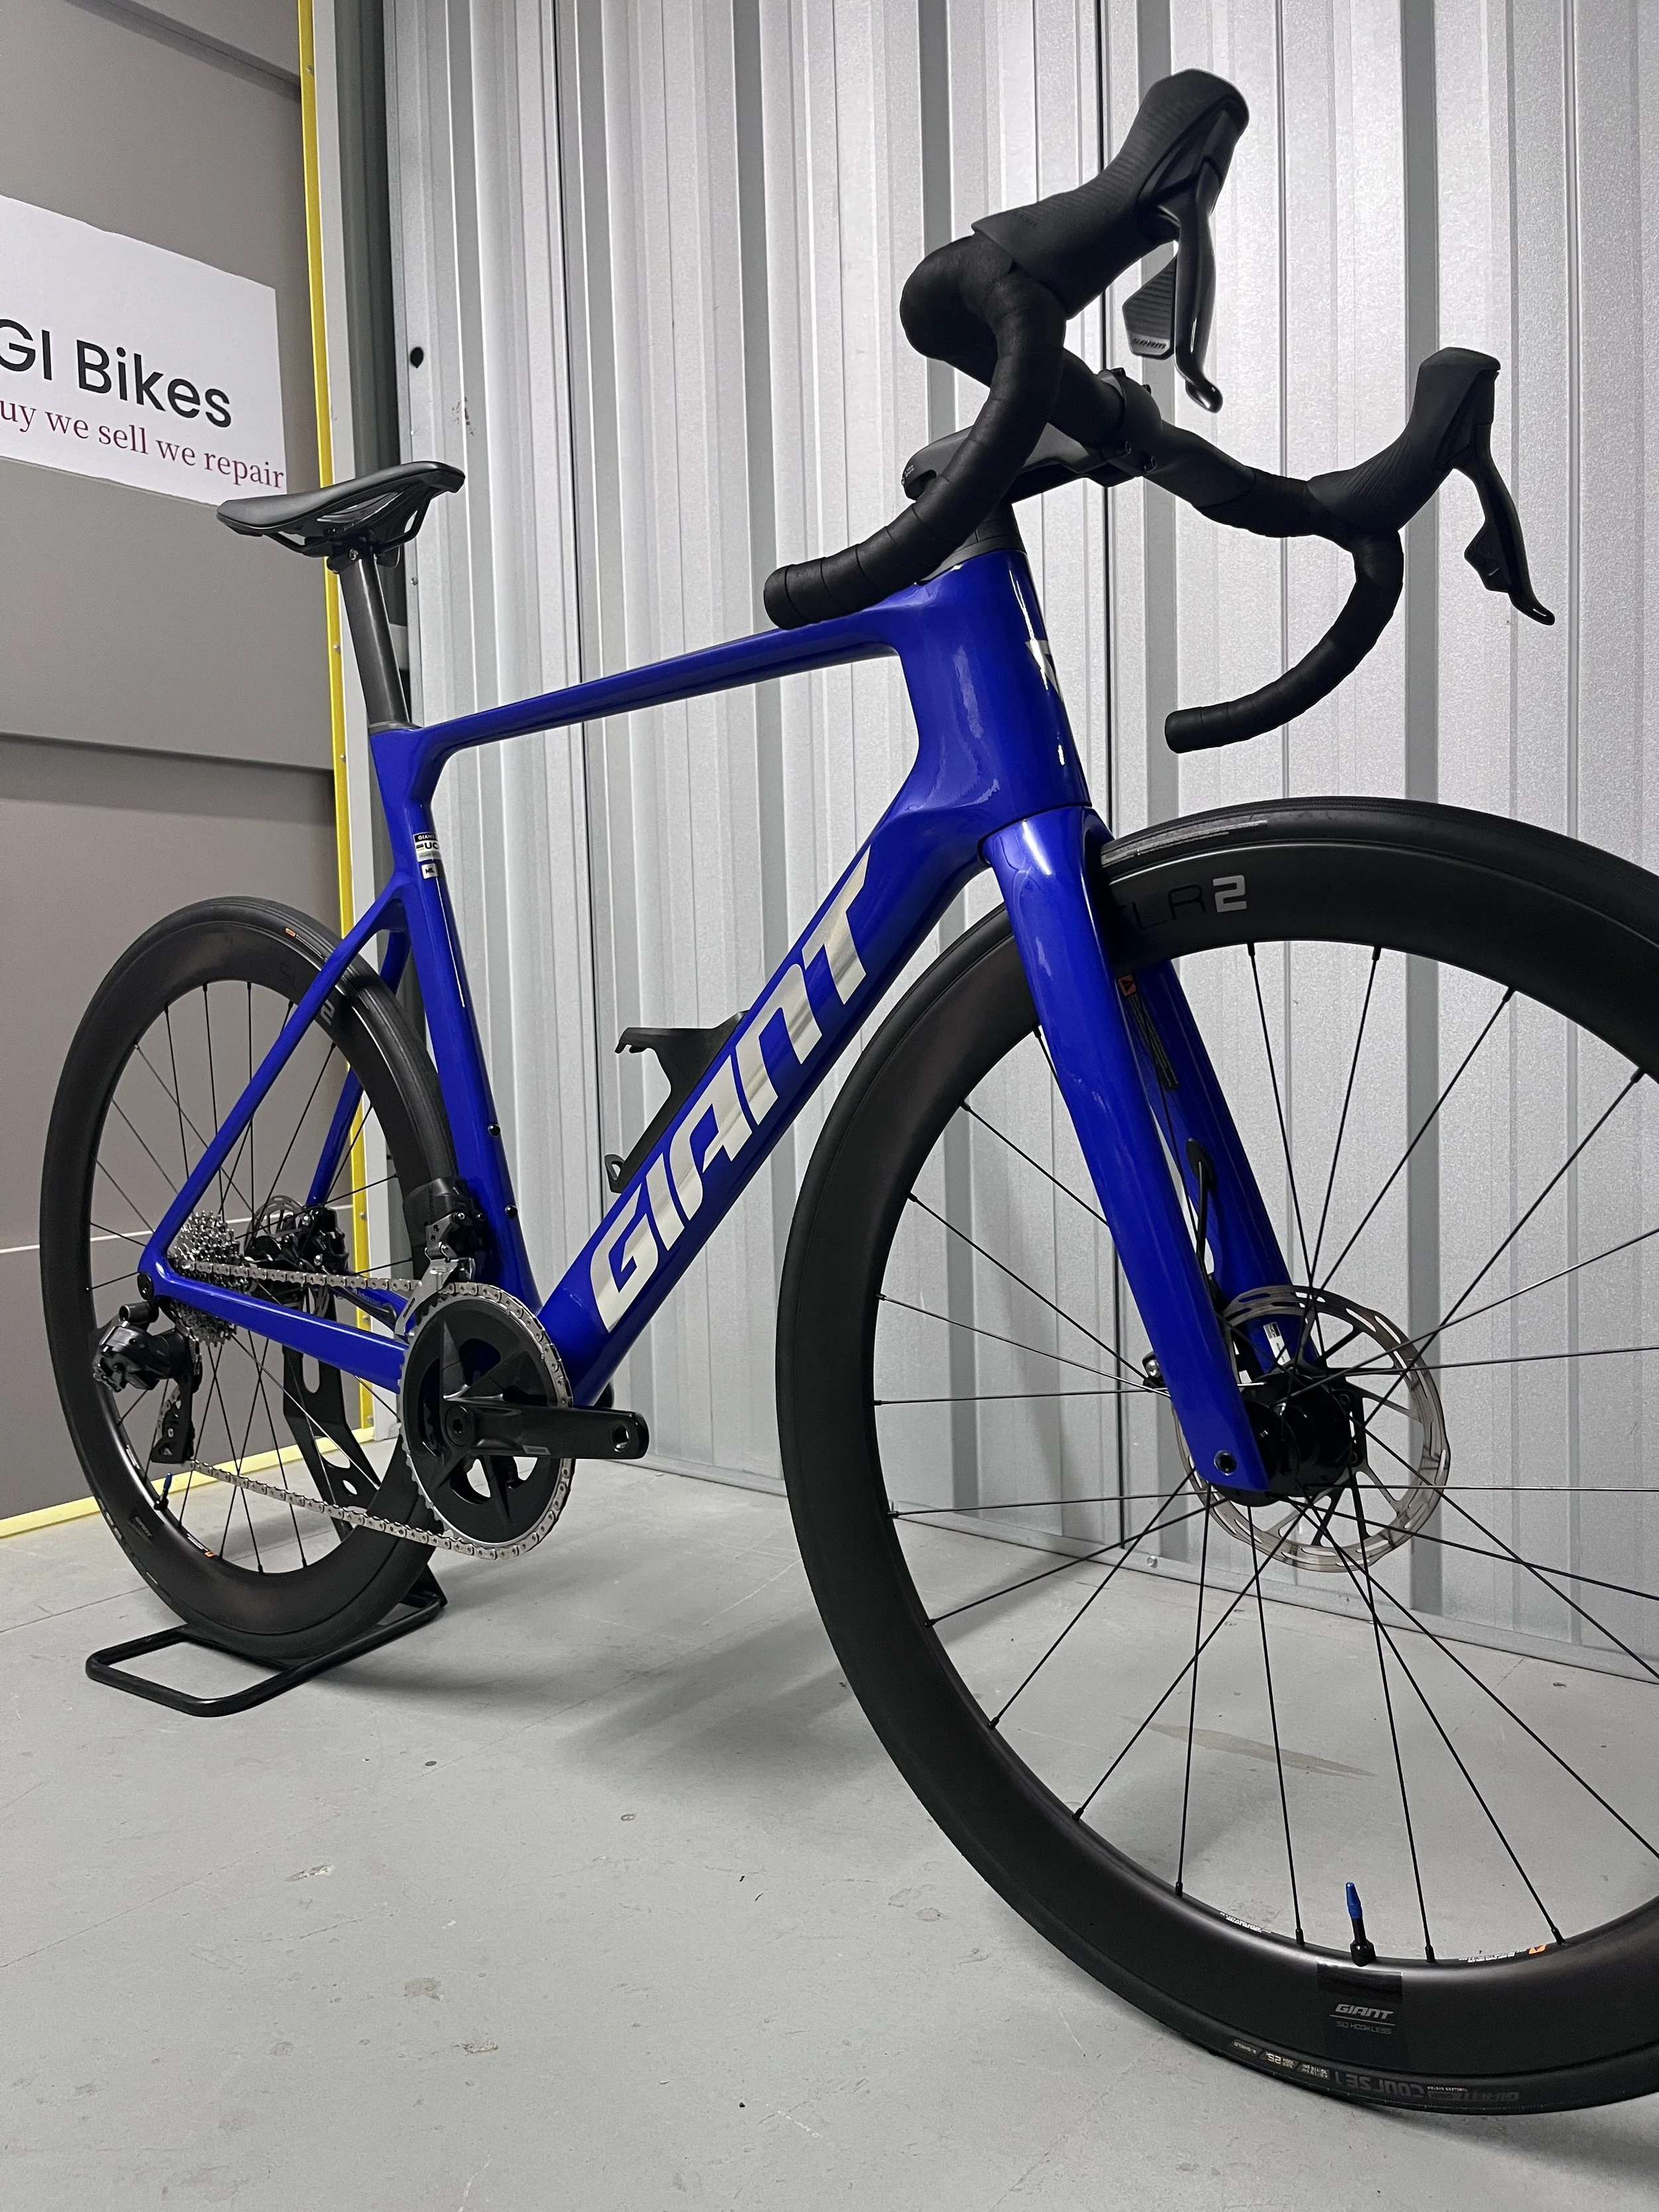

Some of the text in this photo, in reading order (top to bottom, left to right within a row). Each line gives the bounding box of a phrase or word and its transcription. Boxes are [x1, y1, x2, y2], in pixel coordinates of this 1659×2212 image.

[76, 338, 232, 428] Bikes
[45, 410, 90, 439] we
[98, 423, 149, 455] sell
[155, 438, 196, 467] we
[204, 451, 285, 489] repair
[1118, 874, 1248, 930] LR2
[590, 844, 871, 1333] GIANT
[1334, 2004, 1394, 2020] GIANT
[1350, 2022, 1392, 2035] HOOKLESS
[1346, 2073, 1425, 2098] COURSE
